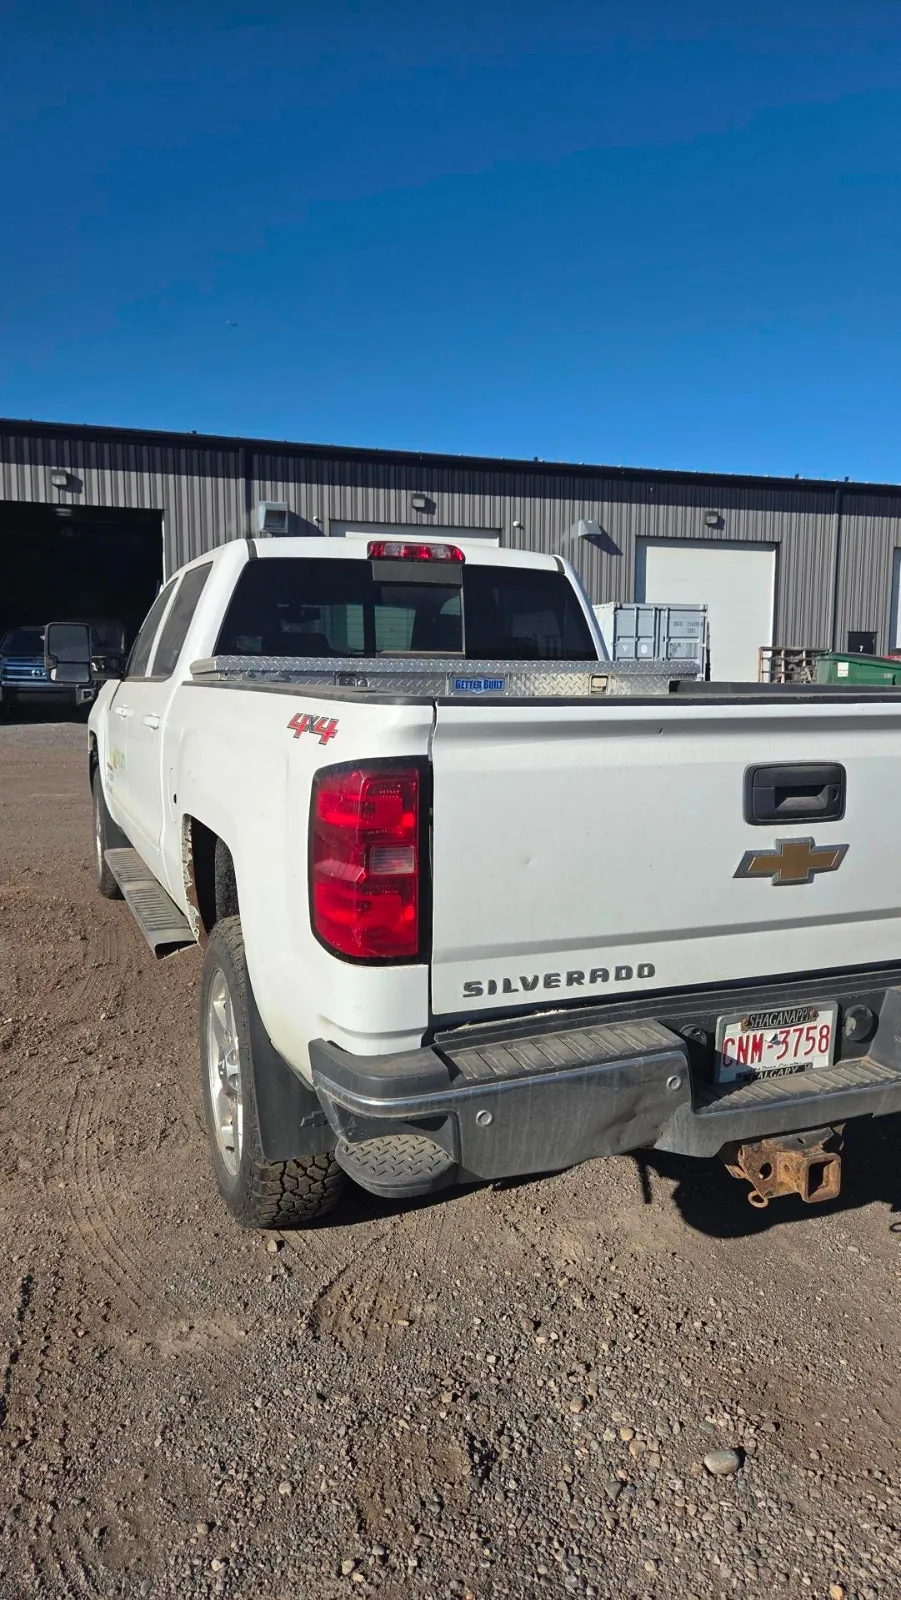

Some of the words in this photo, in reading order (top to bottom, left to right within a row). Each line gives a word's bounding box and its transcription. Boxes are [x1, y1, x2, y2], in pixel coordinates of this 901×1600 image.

[455, 679, 482, 690] BETTER
[483, 679, 503, 690] BUILT
[462, 962, 656, 998] SILVERADO
[750, 1007, 811, 1028] SHAGANAPPI
